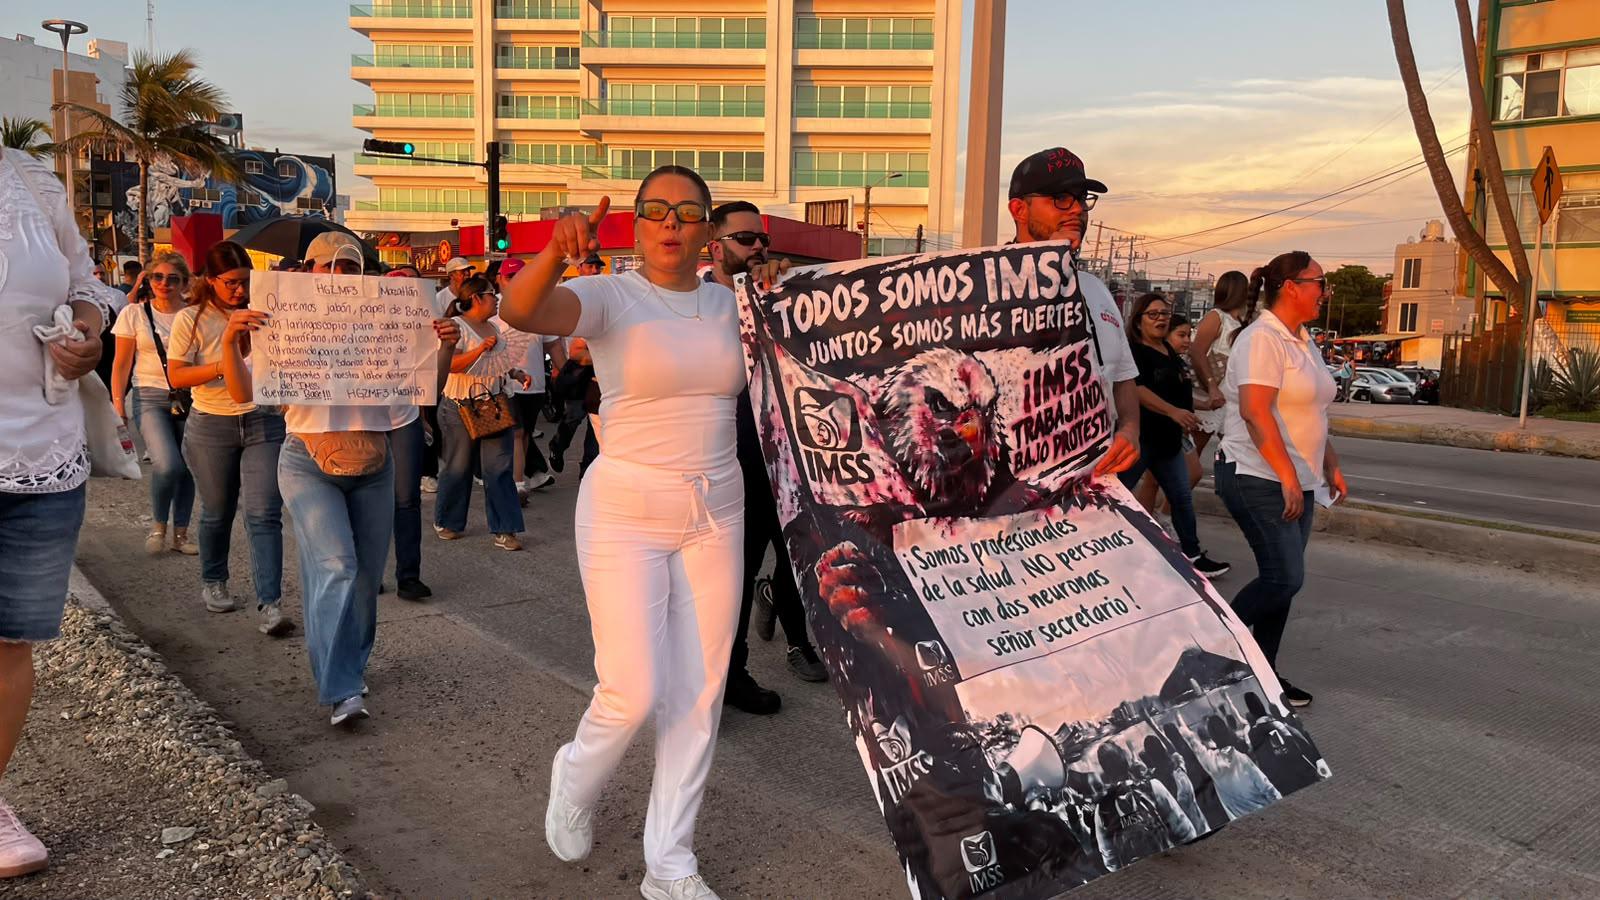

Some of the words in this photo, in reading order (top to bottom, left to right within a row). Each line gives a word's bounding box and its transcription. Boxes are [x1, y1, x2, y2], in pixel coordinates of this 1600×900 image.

[266, 293, 317, 313] Queremos
[360, 303, 386, 319] papel
[389, 304, 402, 315] de
[772, 279, 870, 339] TODOS
[878, 261, 974, 313] SOMOS
[983, 250, 1078, 304] IMSS
[267, 331, 280, 342] de
[286, 319, 348, 334] laringoscopio
[352, 323, 374, 333] para
[379, 321, 399, 331] cada
[402, 321, 422, 331] sala
[805, 325, 883, 367] JUNTOS
[891, 316, 953, 347] SOMOS
[961, 303, 1001, 342] MÁS
[1011, 301, 1083, 336] FUERTES
[318, 348, 340, 360] para
[396, 346, 407, 354] de
[366, 358, 389, 370] dignos
[393, 361, 400, 370] y
[280, 381, 293, 390] del
[362, 370, 382, 379] labor
[1023, 344, 1092, 413] ¡IMSS
[261, 386, 299, 398] Queremos
[806, 449, 875, 485] IMSS
[1014, 441, 1049, 474] BAJO
[902, 544, 970, 577] ¡Somos
[970, 516, 1078, 560] profesionales
[921, 577, 945, 602] de
[946, 572, 966, 598] la
[1021, 554, 1056, 578] NO
[1058, 529, 1134, 571] personas
[962, 607, 994, 628] con
[997, 597, 1030, 620] dos
[1029, 568, 1110, 609] neuronas
[987, 630, 1036, 656] señor
[923, 663, 955, 688] IMSS
[968, 863, 1005, 894] IMSS
